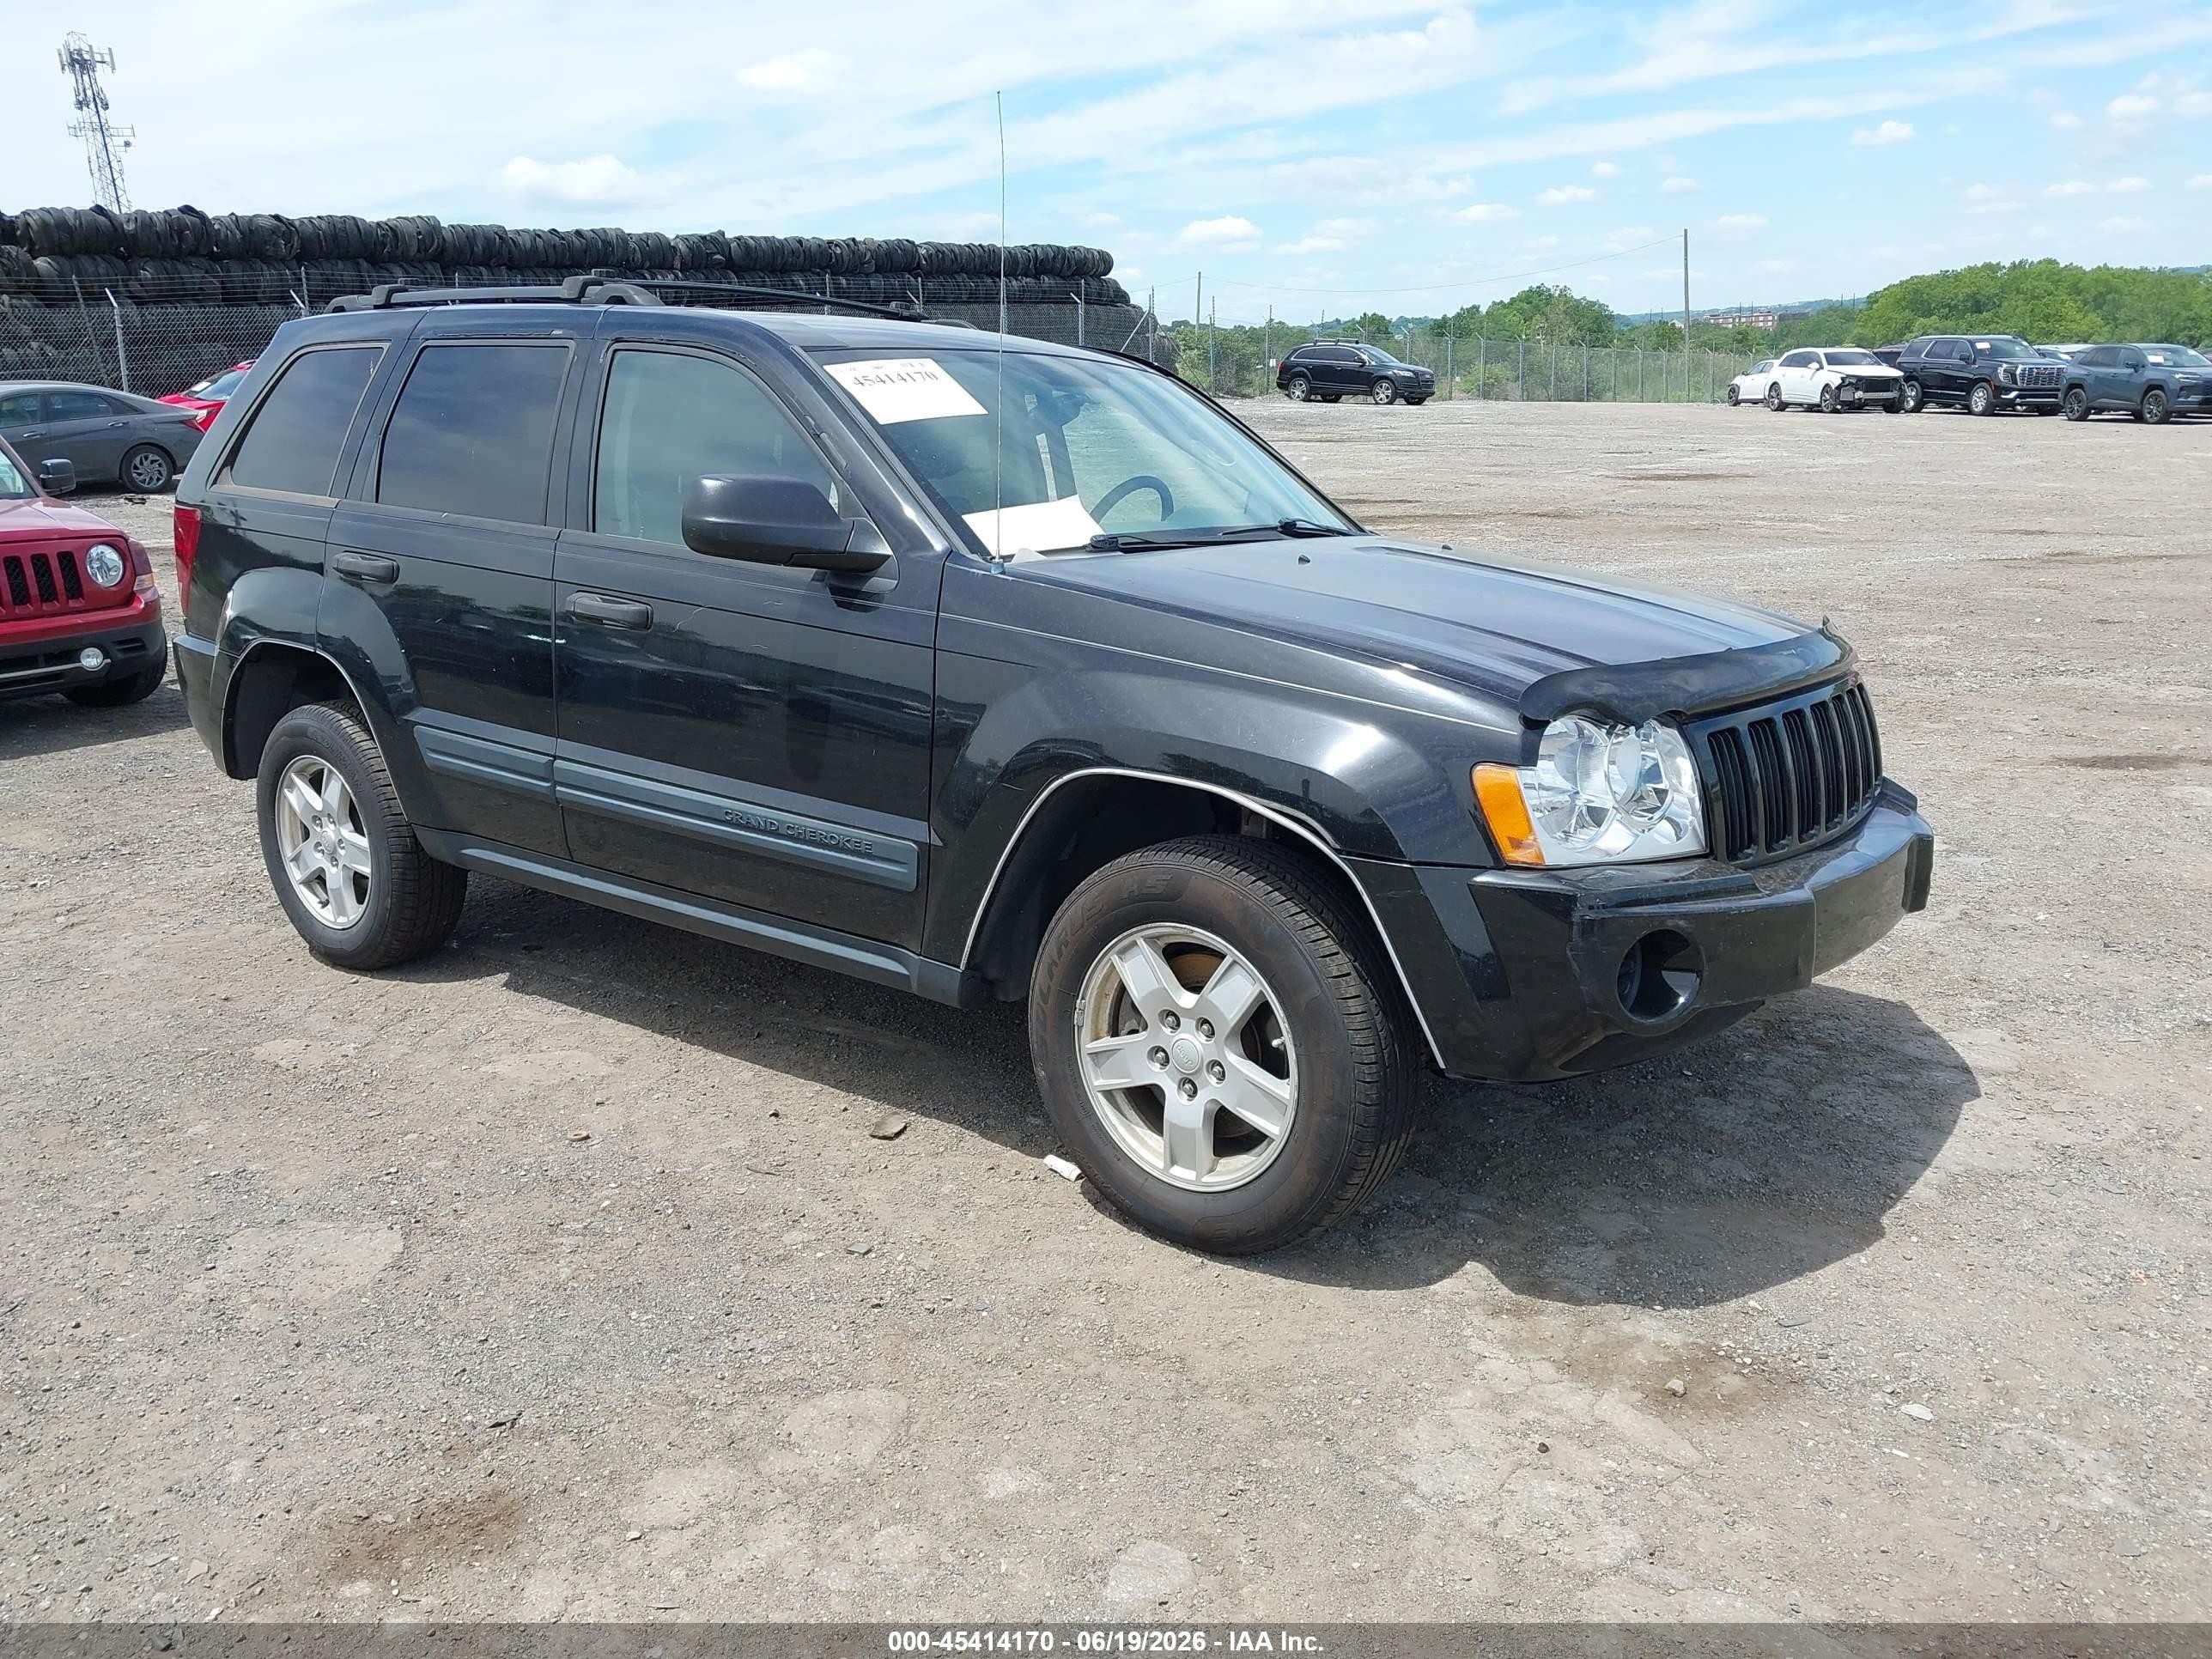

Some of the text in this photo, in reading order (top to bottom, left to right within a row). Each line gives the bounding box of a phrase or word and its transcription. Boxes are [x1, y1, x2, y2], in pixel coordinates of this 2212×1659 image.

[853, 371, 939, 387] 45414170
[723, 809, 873, 854] GRAND CHEROKEE
